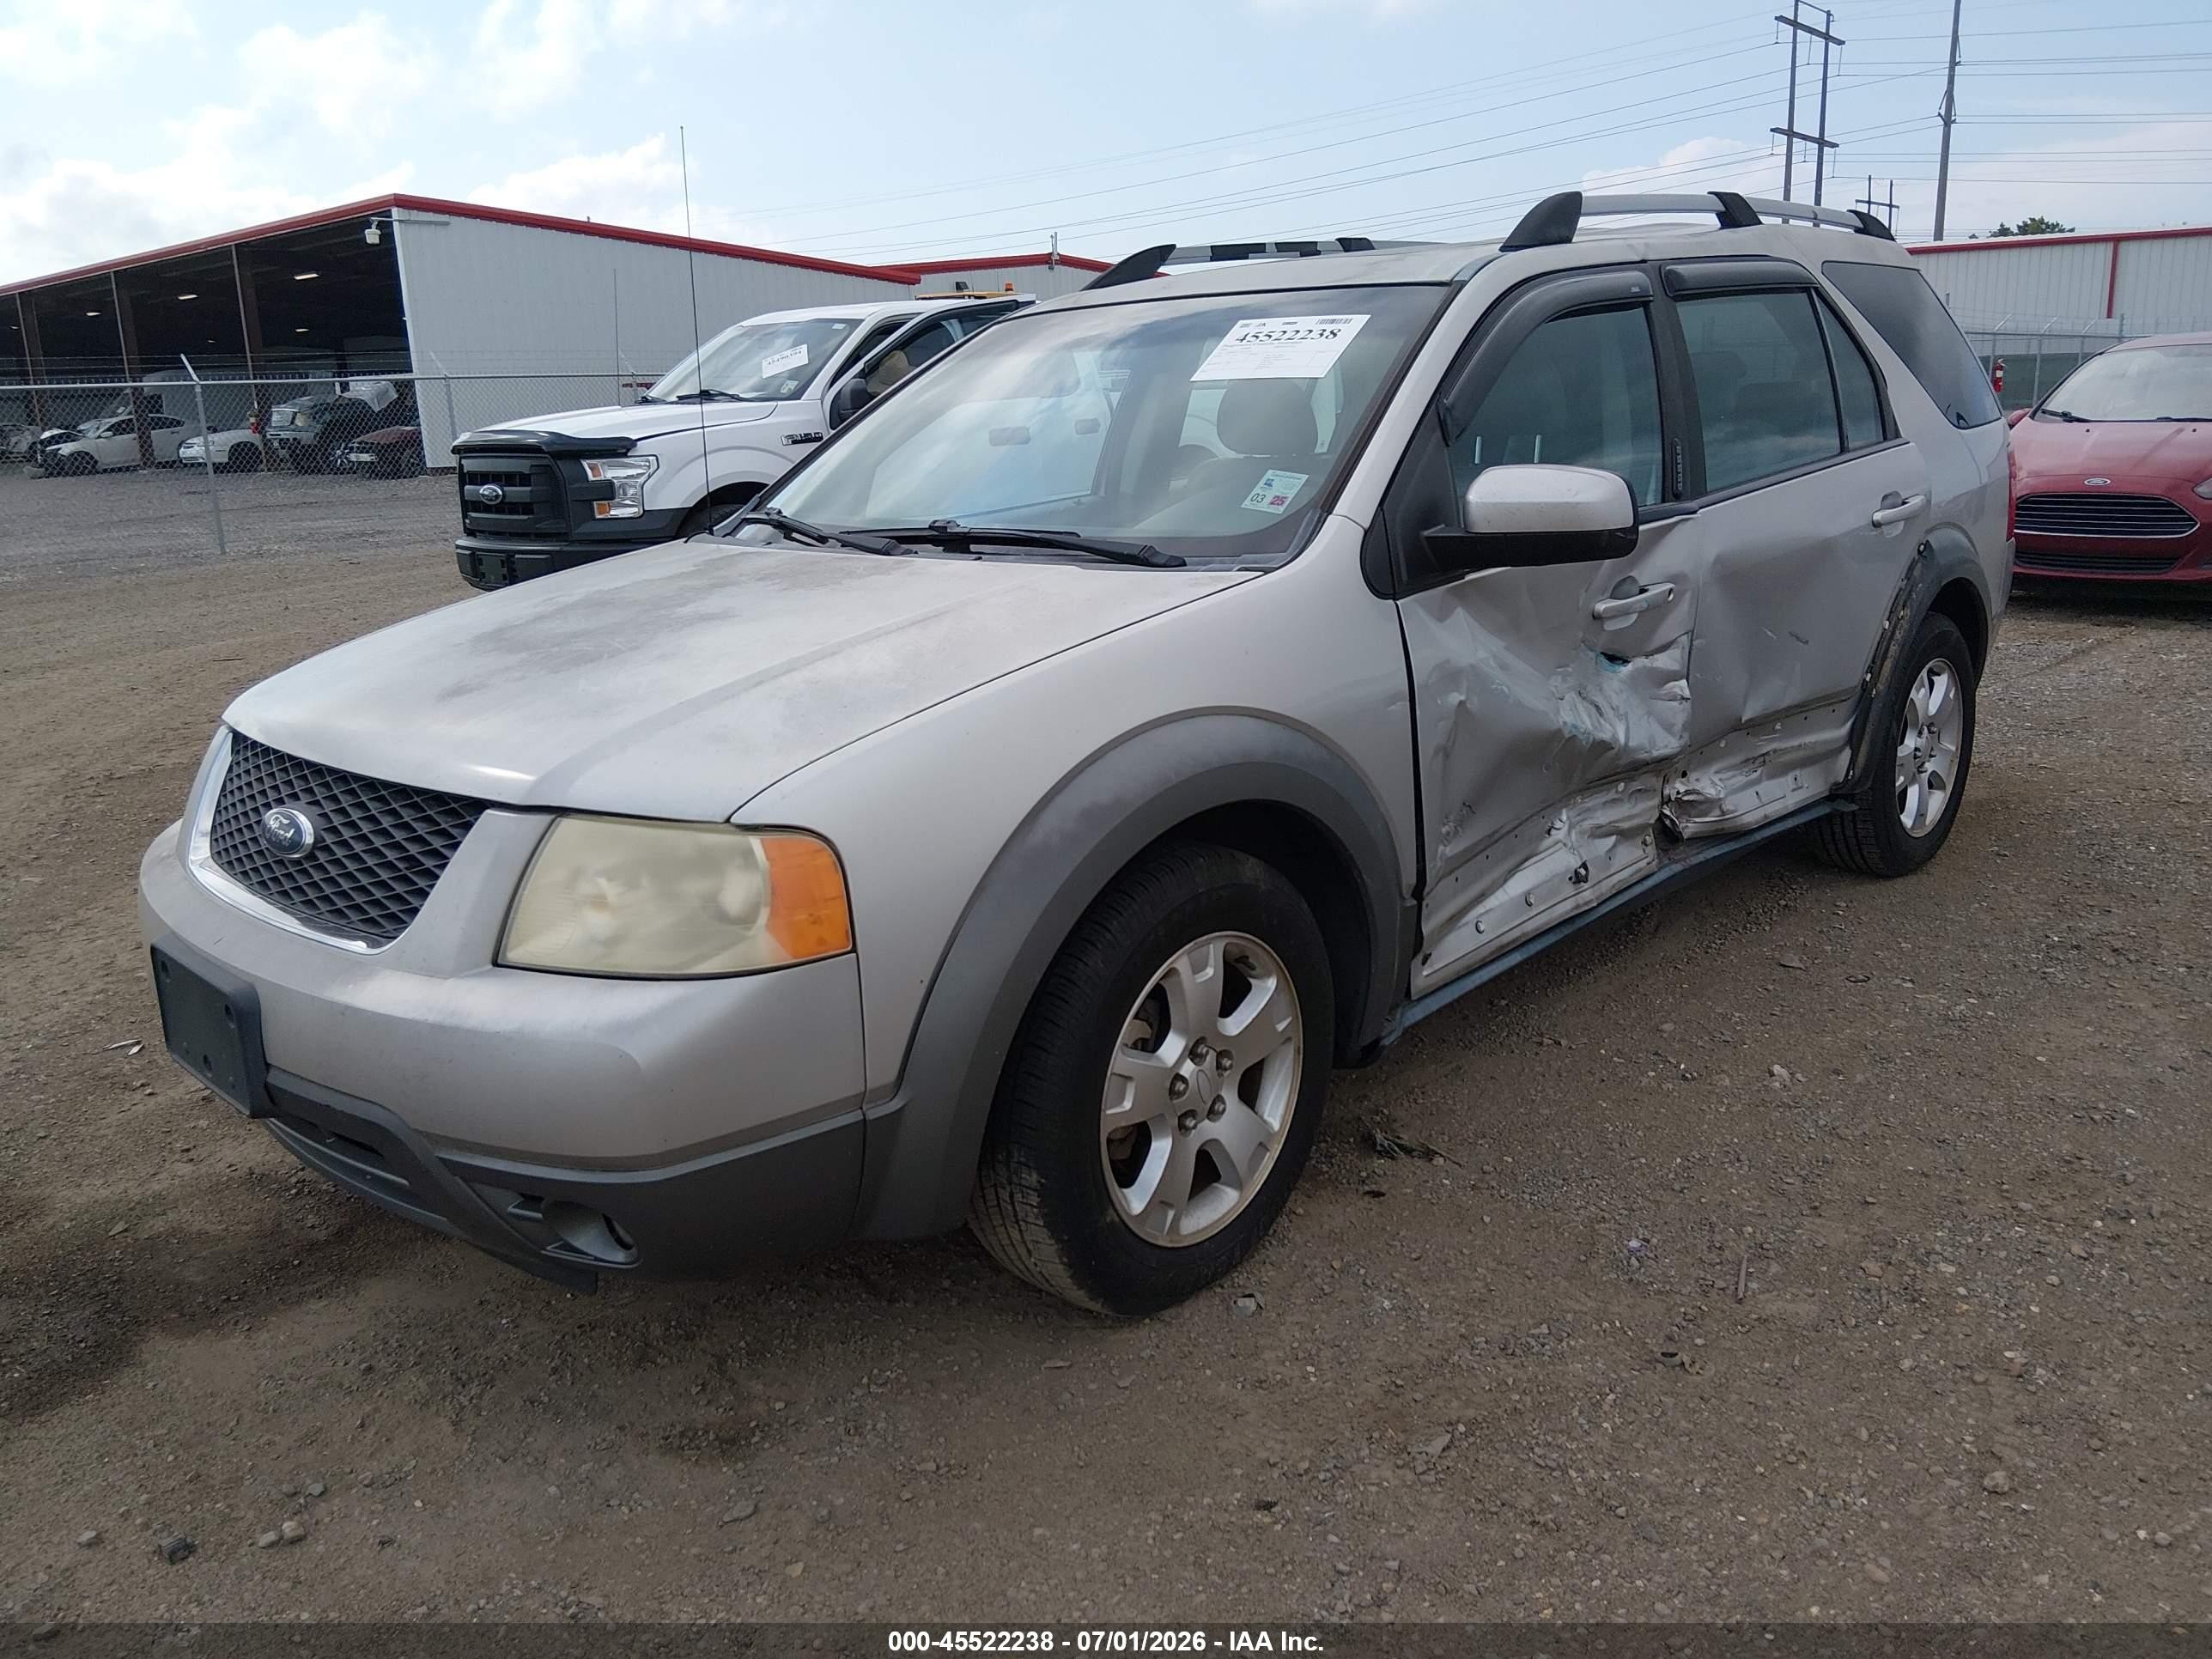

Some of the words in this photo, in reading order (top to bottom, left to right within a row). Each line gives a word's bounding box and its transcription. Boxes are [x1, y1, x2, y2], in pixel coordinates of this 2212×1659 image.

[1235, 328, 1341, 343] 45522238
[1250, 493, 1266, 503] 03
[1269, 495, 1288, 506] 25
[265, 814, 296, 846] Ford
